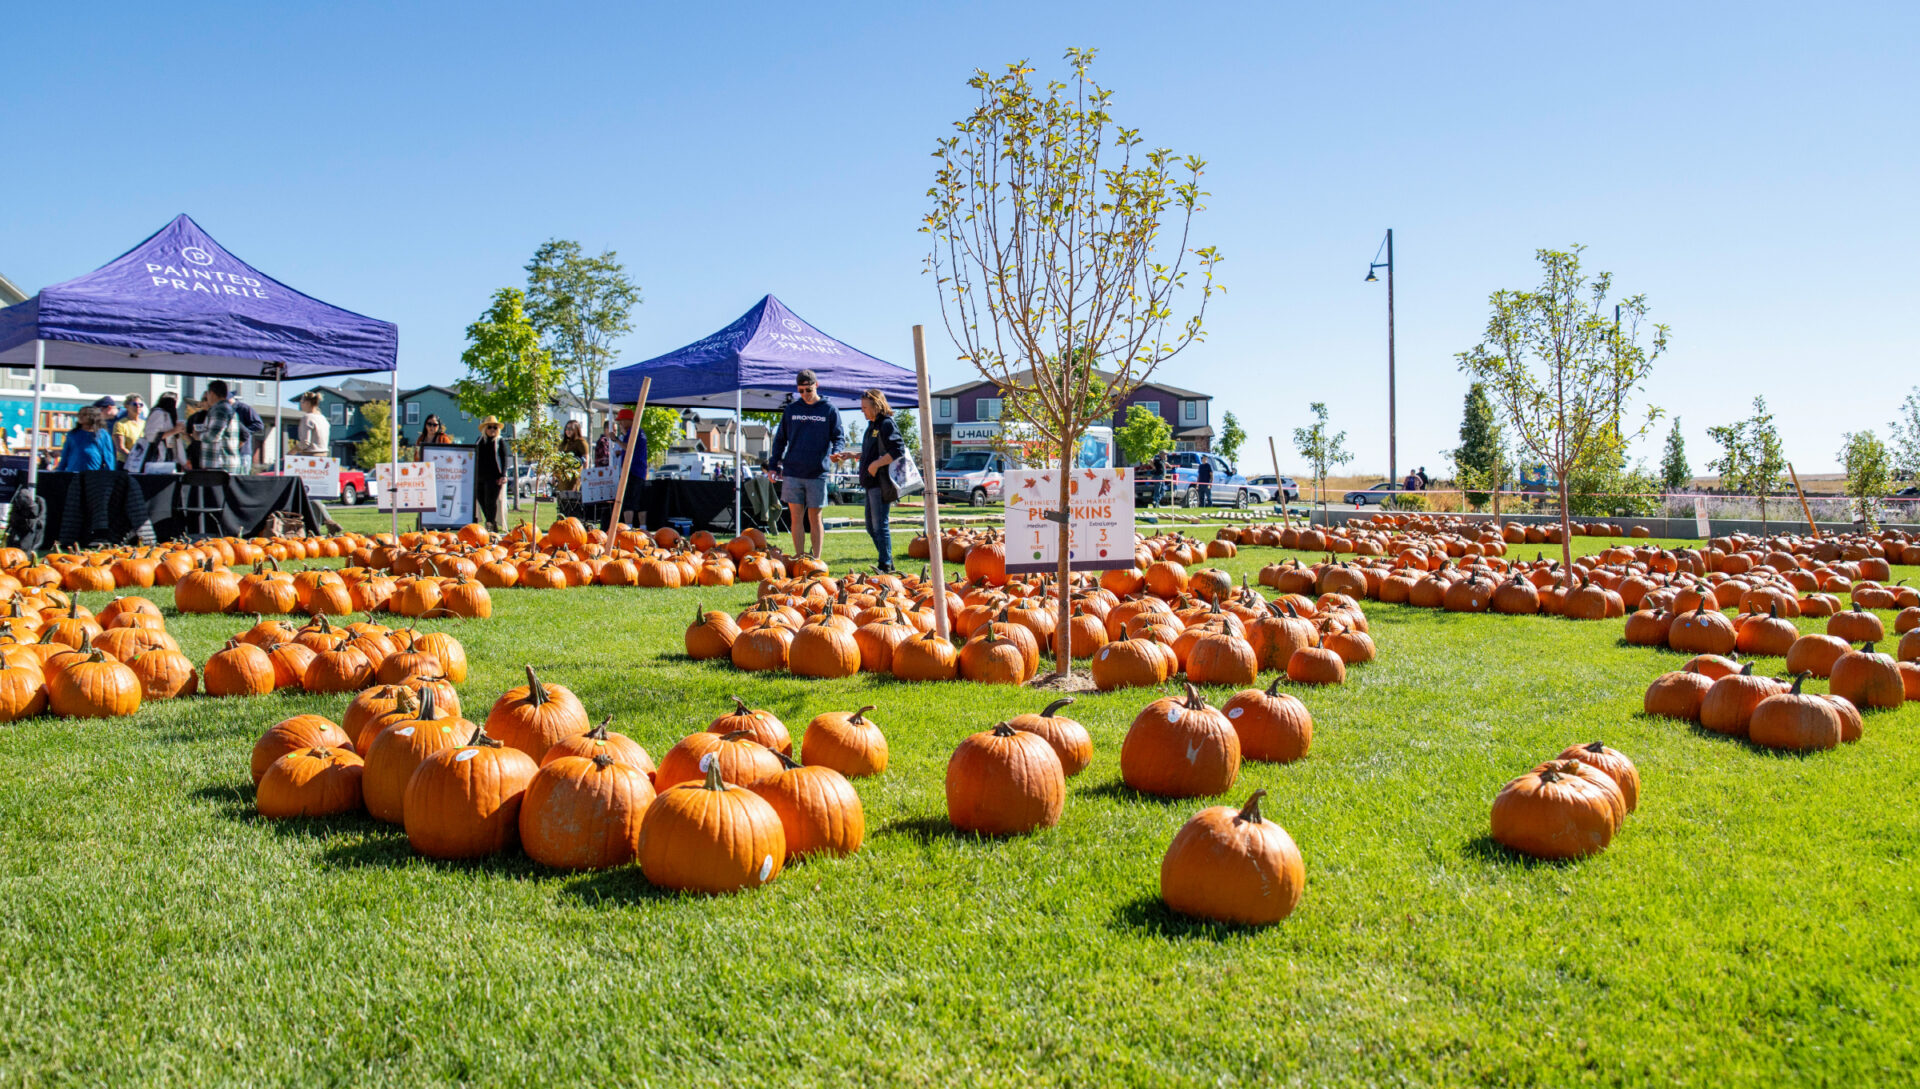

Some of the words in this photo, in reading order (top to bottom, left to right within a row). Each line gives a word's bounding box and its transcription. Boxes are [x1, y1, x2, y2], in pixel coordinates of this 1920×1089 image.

[146, 263, 261, 287] PAINTED
[152, 276, 270, 299] PRAIRIE
[769, 332, 835, 347] PAINTED
[777, 340, 847, 355] PRAIRIE
[957, 429, 995, 439] U-HAUL
[1034, 530, 1040, 544] 1
[1099, 529, 1107, 542] 3
